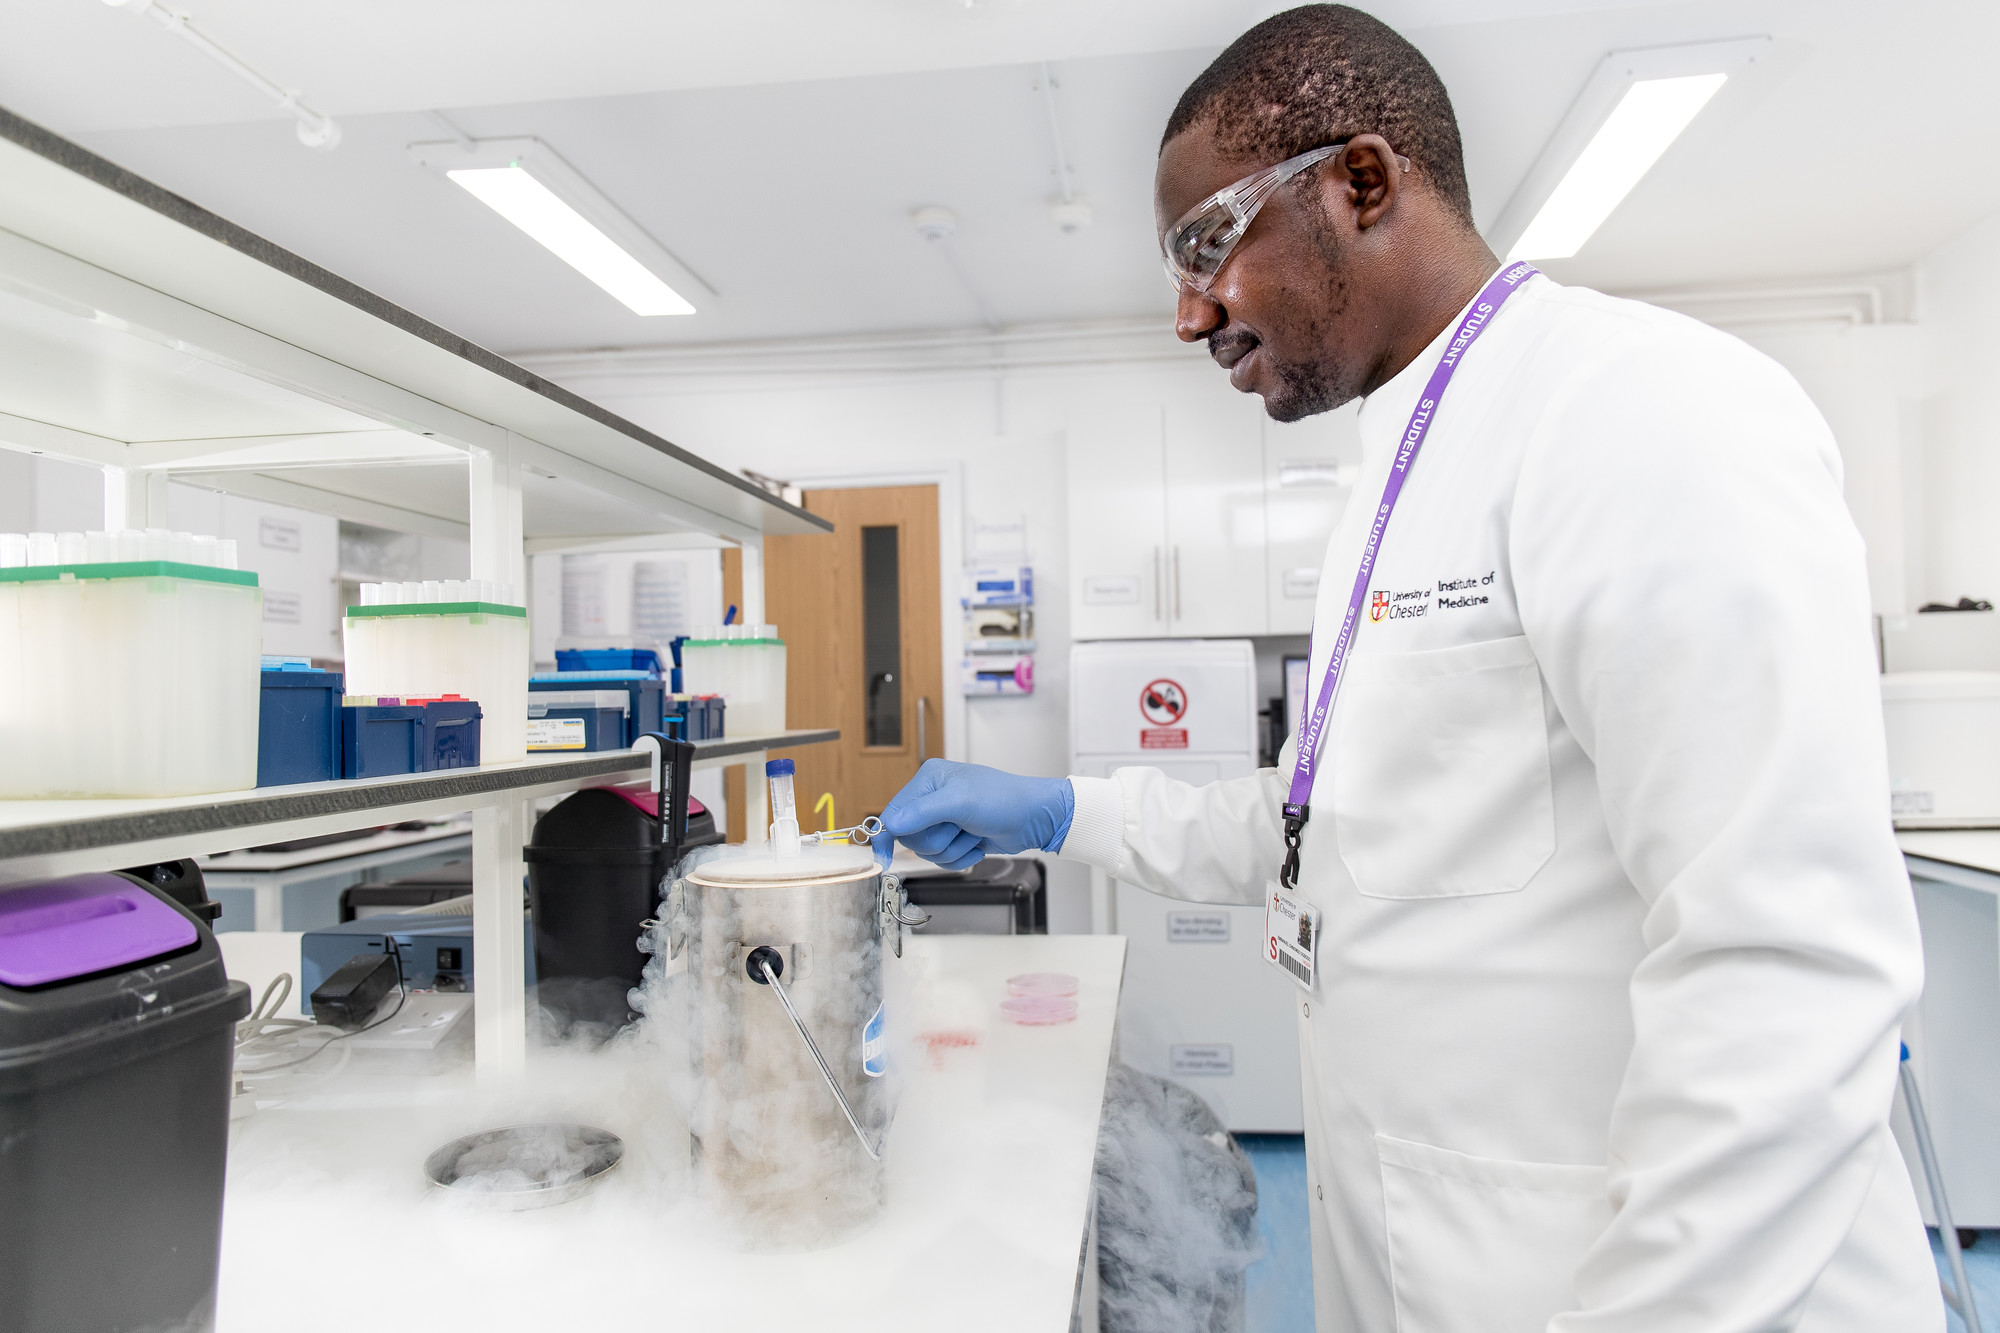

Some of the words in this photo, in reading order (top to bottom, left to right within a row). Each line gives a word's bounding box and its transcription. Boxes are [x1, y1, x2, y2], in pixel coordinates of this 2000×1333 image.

[1443, 302, 1493, 367] STUDENT
[1395, 398, 1434, 473] STUDENT
[1360, 503, 1390, 577] STUDENT
[1392, 588, 1422, 602] University
[1438, 578, 1477, 592] Institute
[1481, 571, 1495, 585] of
[1438, 595, 1489, 609] Medicine
[1389, 603, 1429, 620] Chester
[1330, 606, 1355, 678] STUDENT
[1299, 706, 1325, 776] STUDENT
[1270, 936, 1278, 960] S
